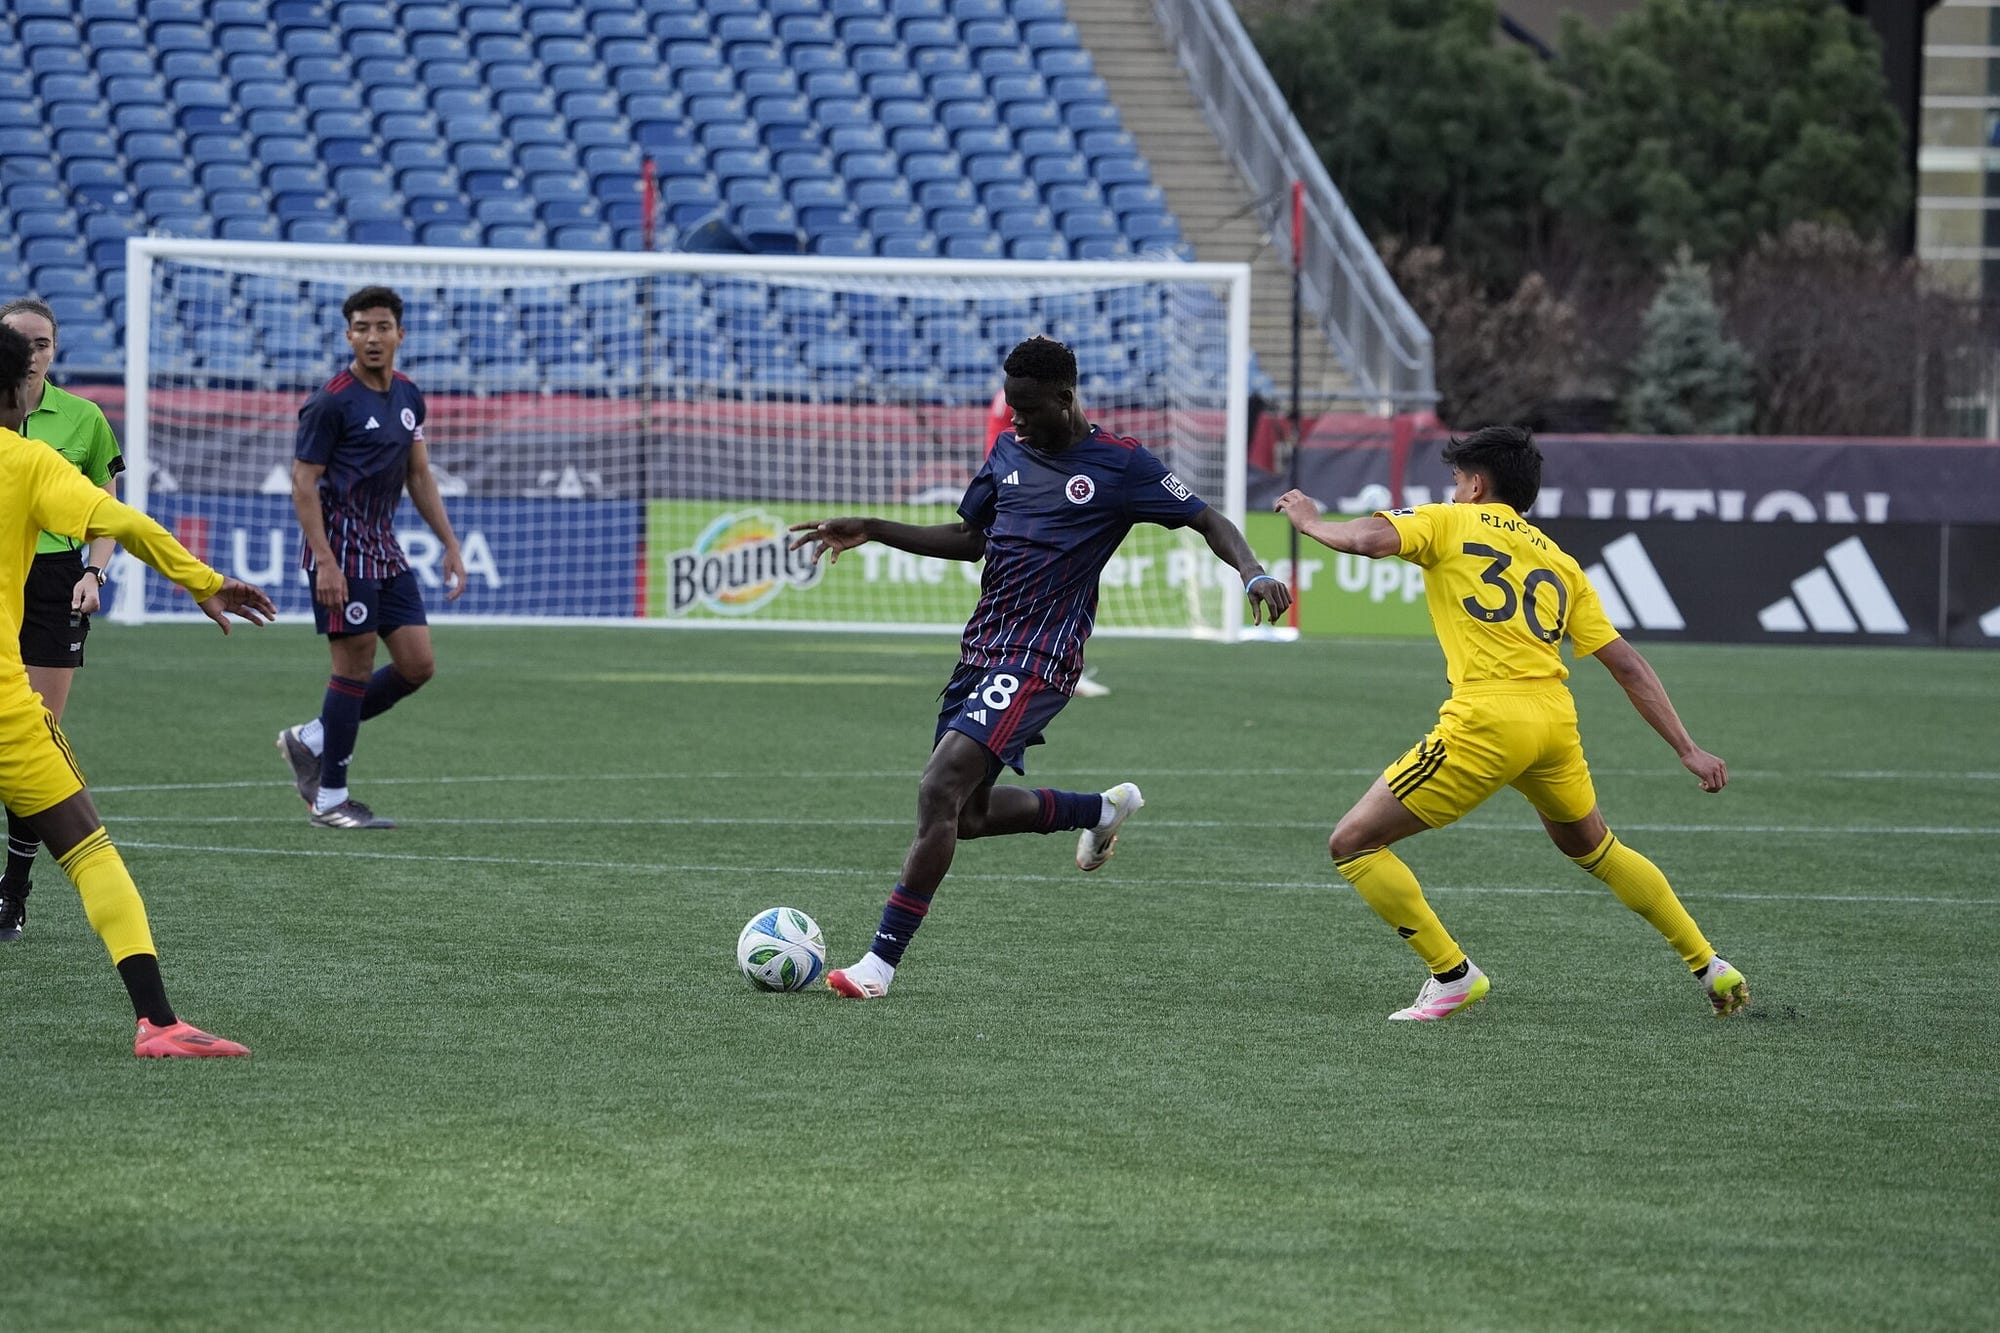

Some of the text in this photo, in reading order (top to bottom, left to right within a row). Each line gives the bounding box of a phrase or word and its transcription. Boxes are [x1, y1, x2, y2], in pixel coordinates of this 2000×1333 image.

[233, 528, 501, 589] URA
[672, 533, 819, 611] Bounty
[858, 541, 946, 584] The
[1462, 542, 1567, 644] 30
